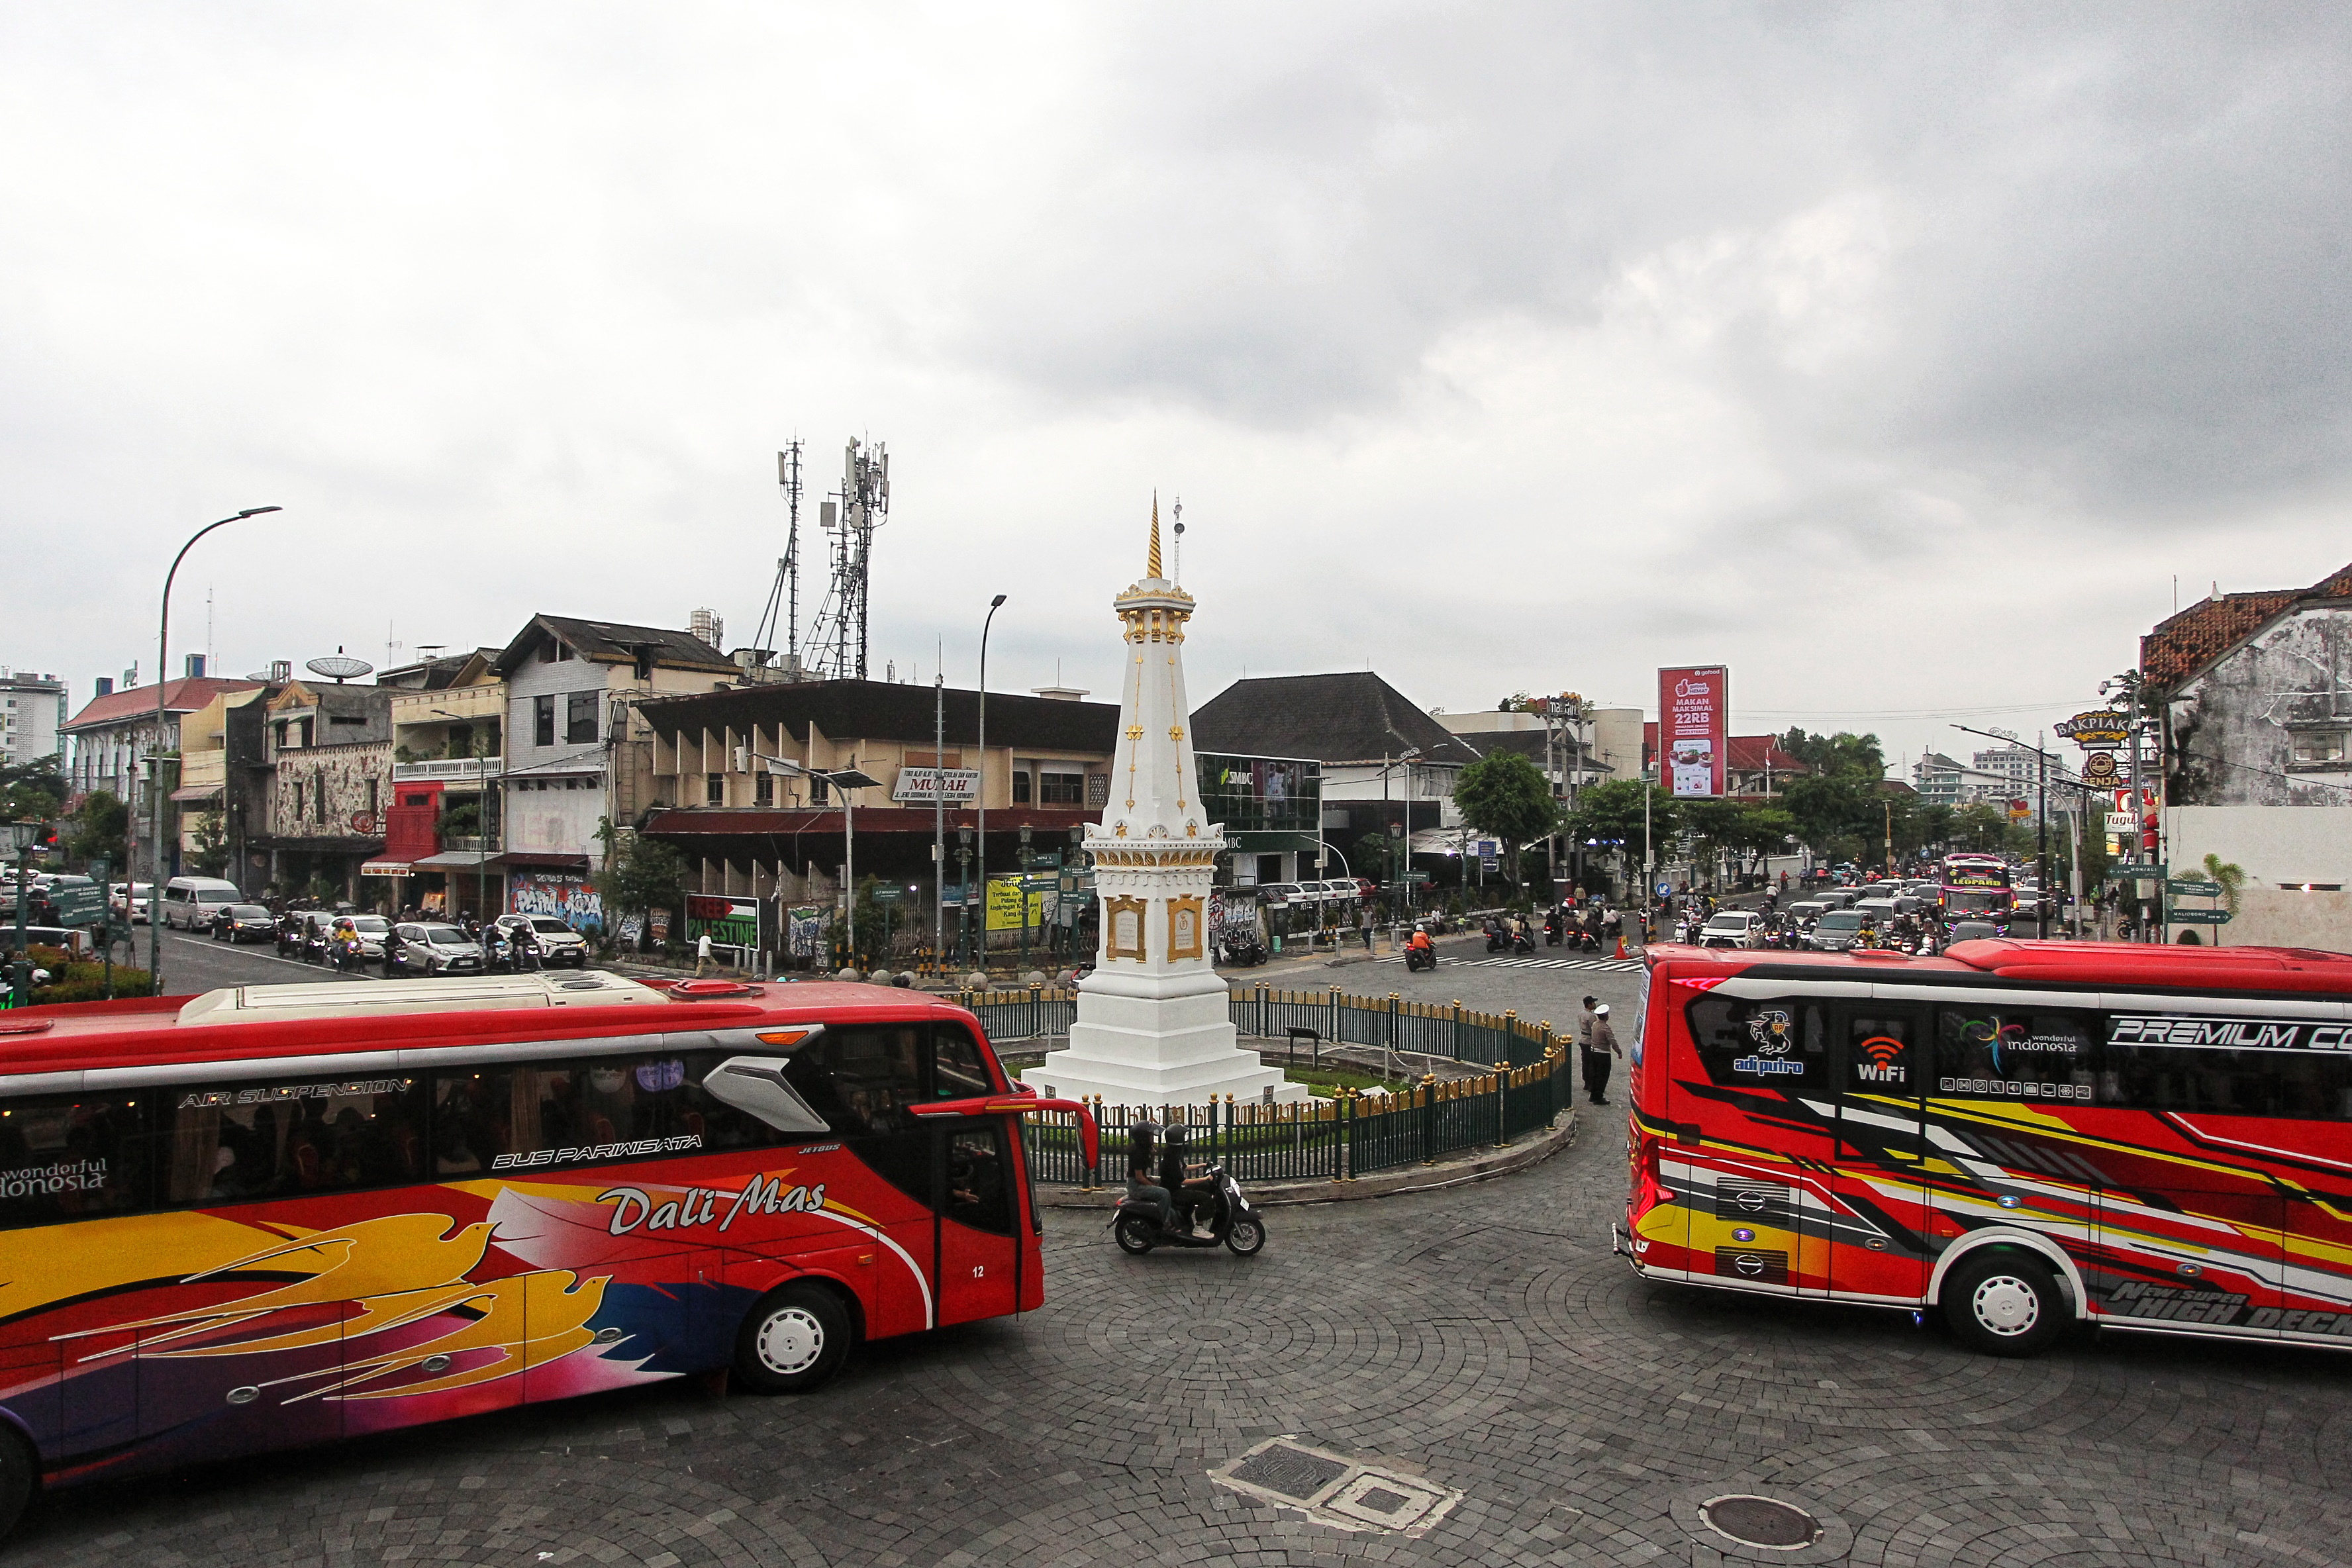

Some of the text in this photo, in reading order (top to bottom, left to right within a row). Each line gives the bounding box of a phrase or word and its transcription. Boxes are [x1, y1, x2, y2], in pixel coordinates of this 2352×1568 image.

[1675, 712, 1709, 724] 22RB
[1230, 771, 1253, 785] SMBC
[2082, 777, 2121, 786] SENJA
[2106, 814, 2133, 826] Tugu
[1225, 836, 1242, 848] MBC
[687, 897, 727, 920] FREE
[2111, 1020, 2299, 1048] PREMIUM
[2006, 1040, 2078, 1053] indonesia
[1857, 1063, 1904, 1082] WiFi
[177, 1079, 409, 1108] AIR SUSPENSION
[492, 1134, 702, 1169] BUS PARIWISATA
[798, 1144, 841, 1154] JETBUS
[1, 1158, 107, 1181] wonderful
[596, 1173, 826, 1236] Dali Mas
[973, 1265, 984, 1278] 12
